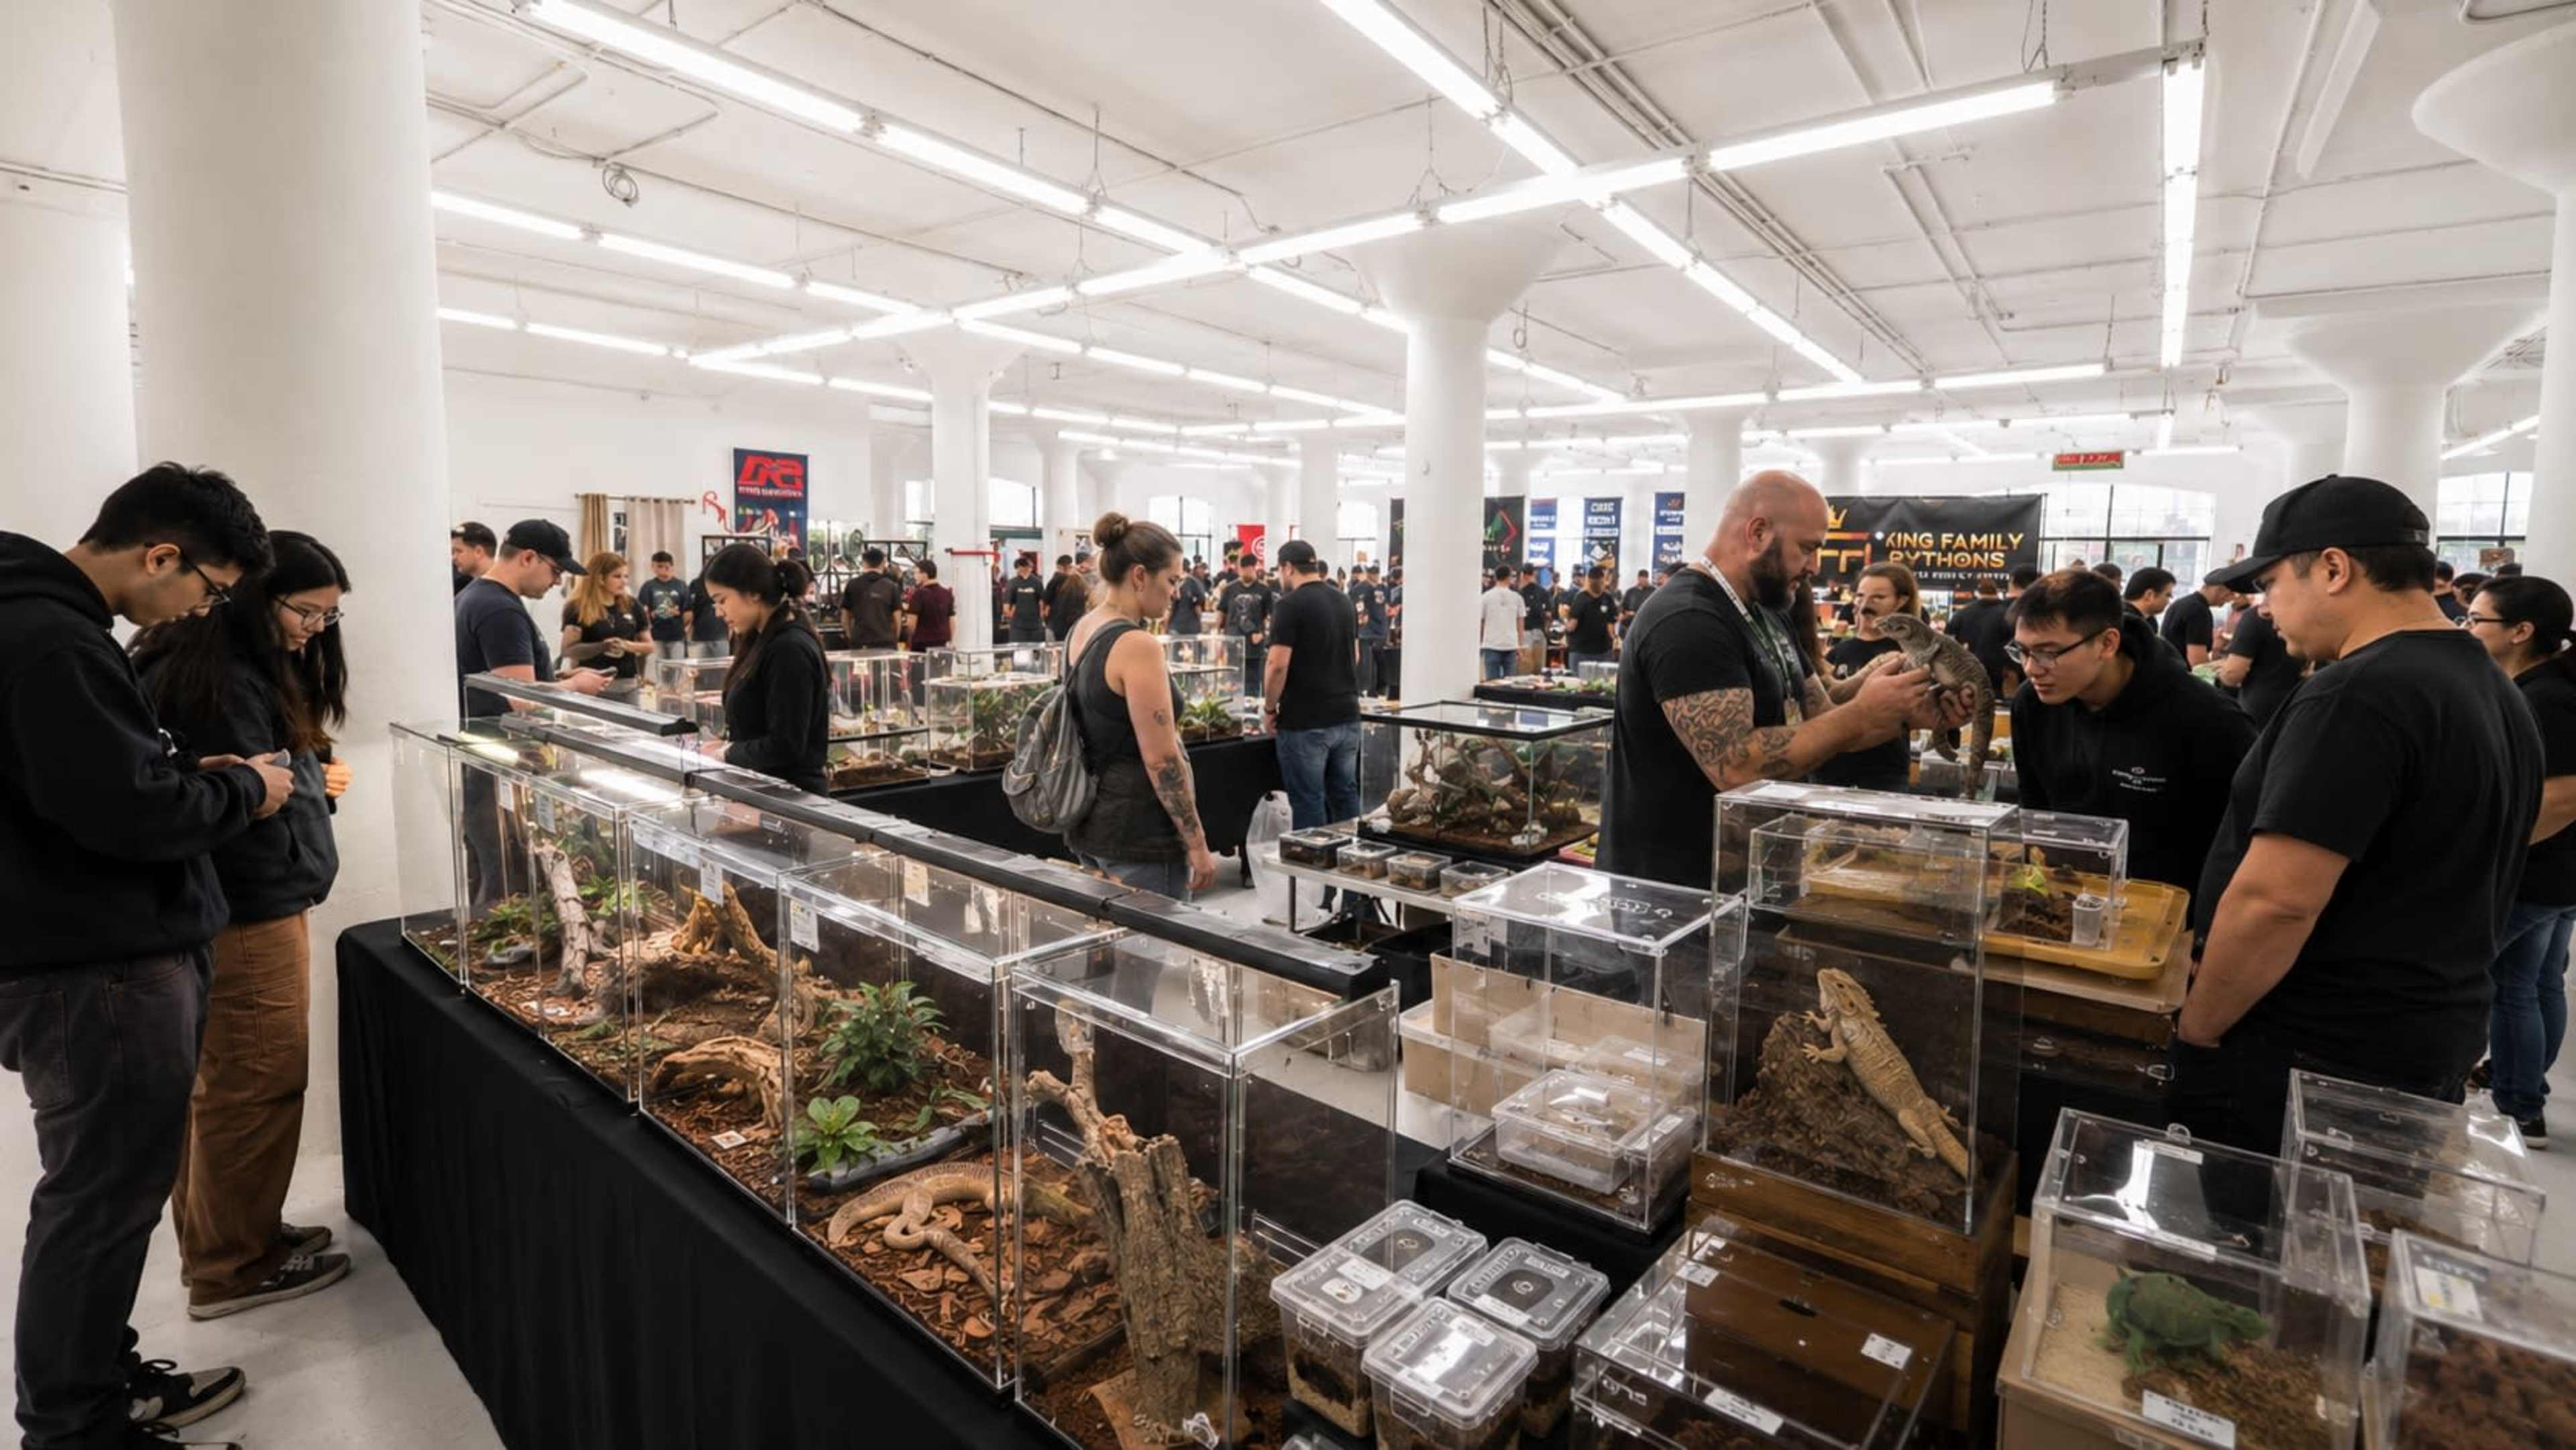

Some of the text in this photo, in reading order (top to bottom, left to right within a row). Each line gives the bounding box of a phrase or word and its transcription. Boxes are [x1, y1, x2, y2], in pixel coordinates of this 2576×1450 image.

[1885, 531, 2024, 550] KING FAMILY
[1888, 550, 2006, 568] PYTHONS
